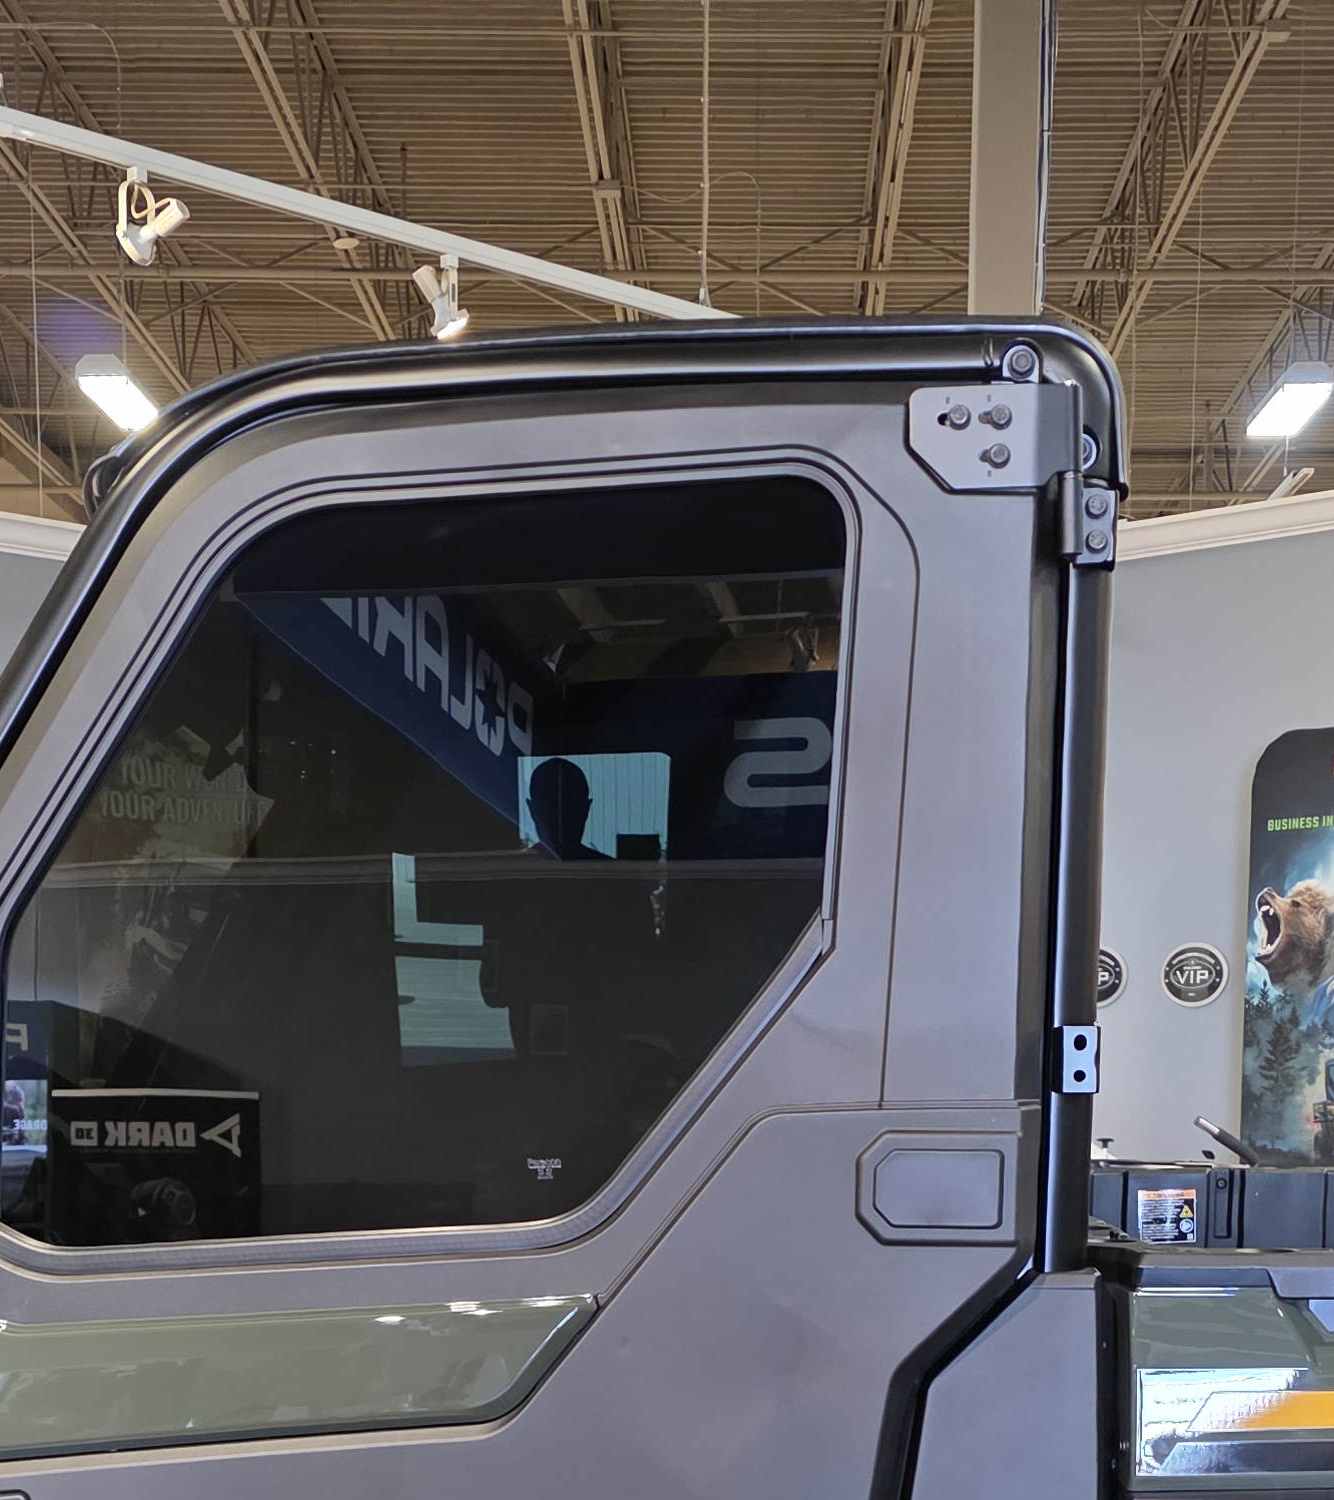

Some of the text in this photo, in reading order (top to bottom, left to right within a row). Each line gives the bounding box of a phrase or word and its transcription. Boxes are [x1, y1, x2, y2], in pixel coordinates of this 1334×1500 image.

[186, 763, 248, 792] WRLD
[101, 789, 157, 821] YOUR
[1267, 816, 1319, 831] BUSINESS
[1322, 815, 1334, 827] IN
[1175, 970, 1209, 984] VIP
